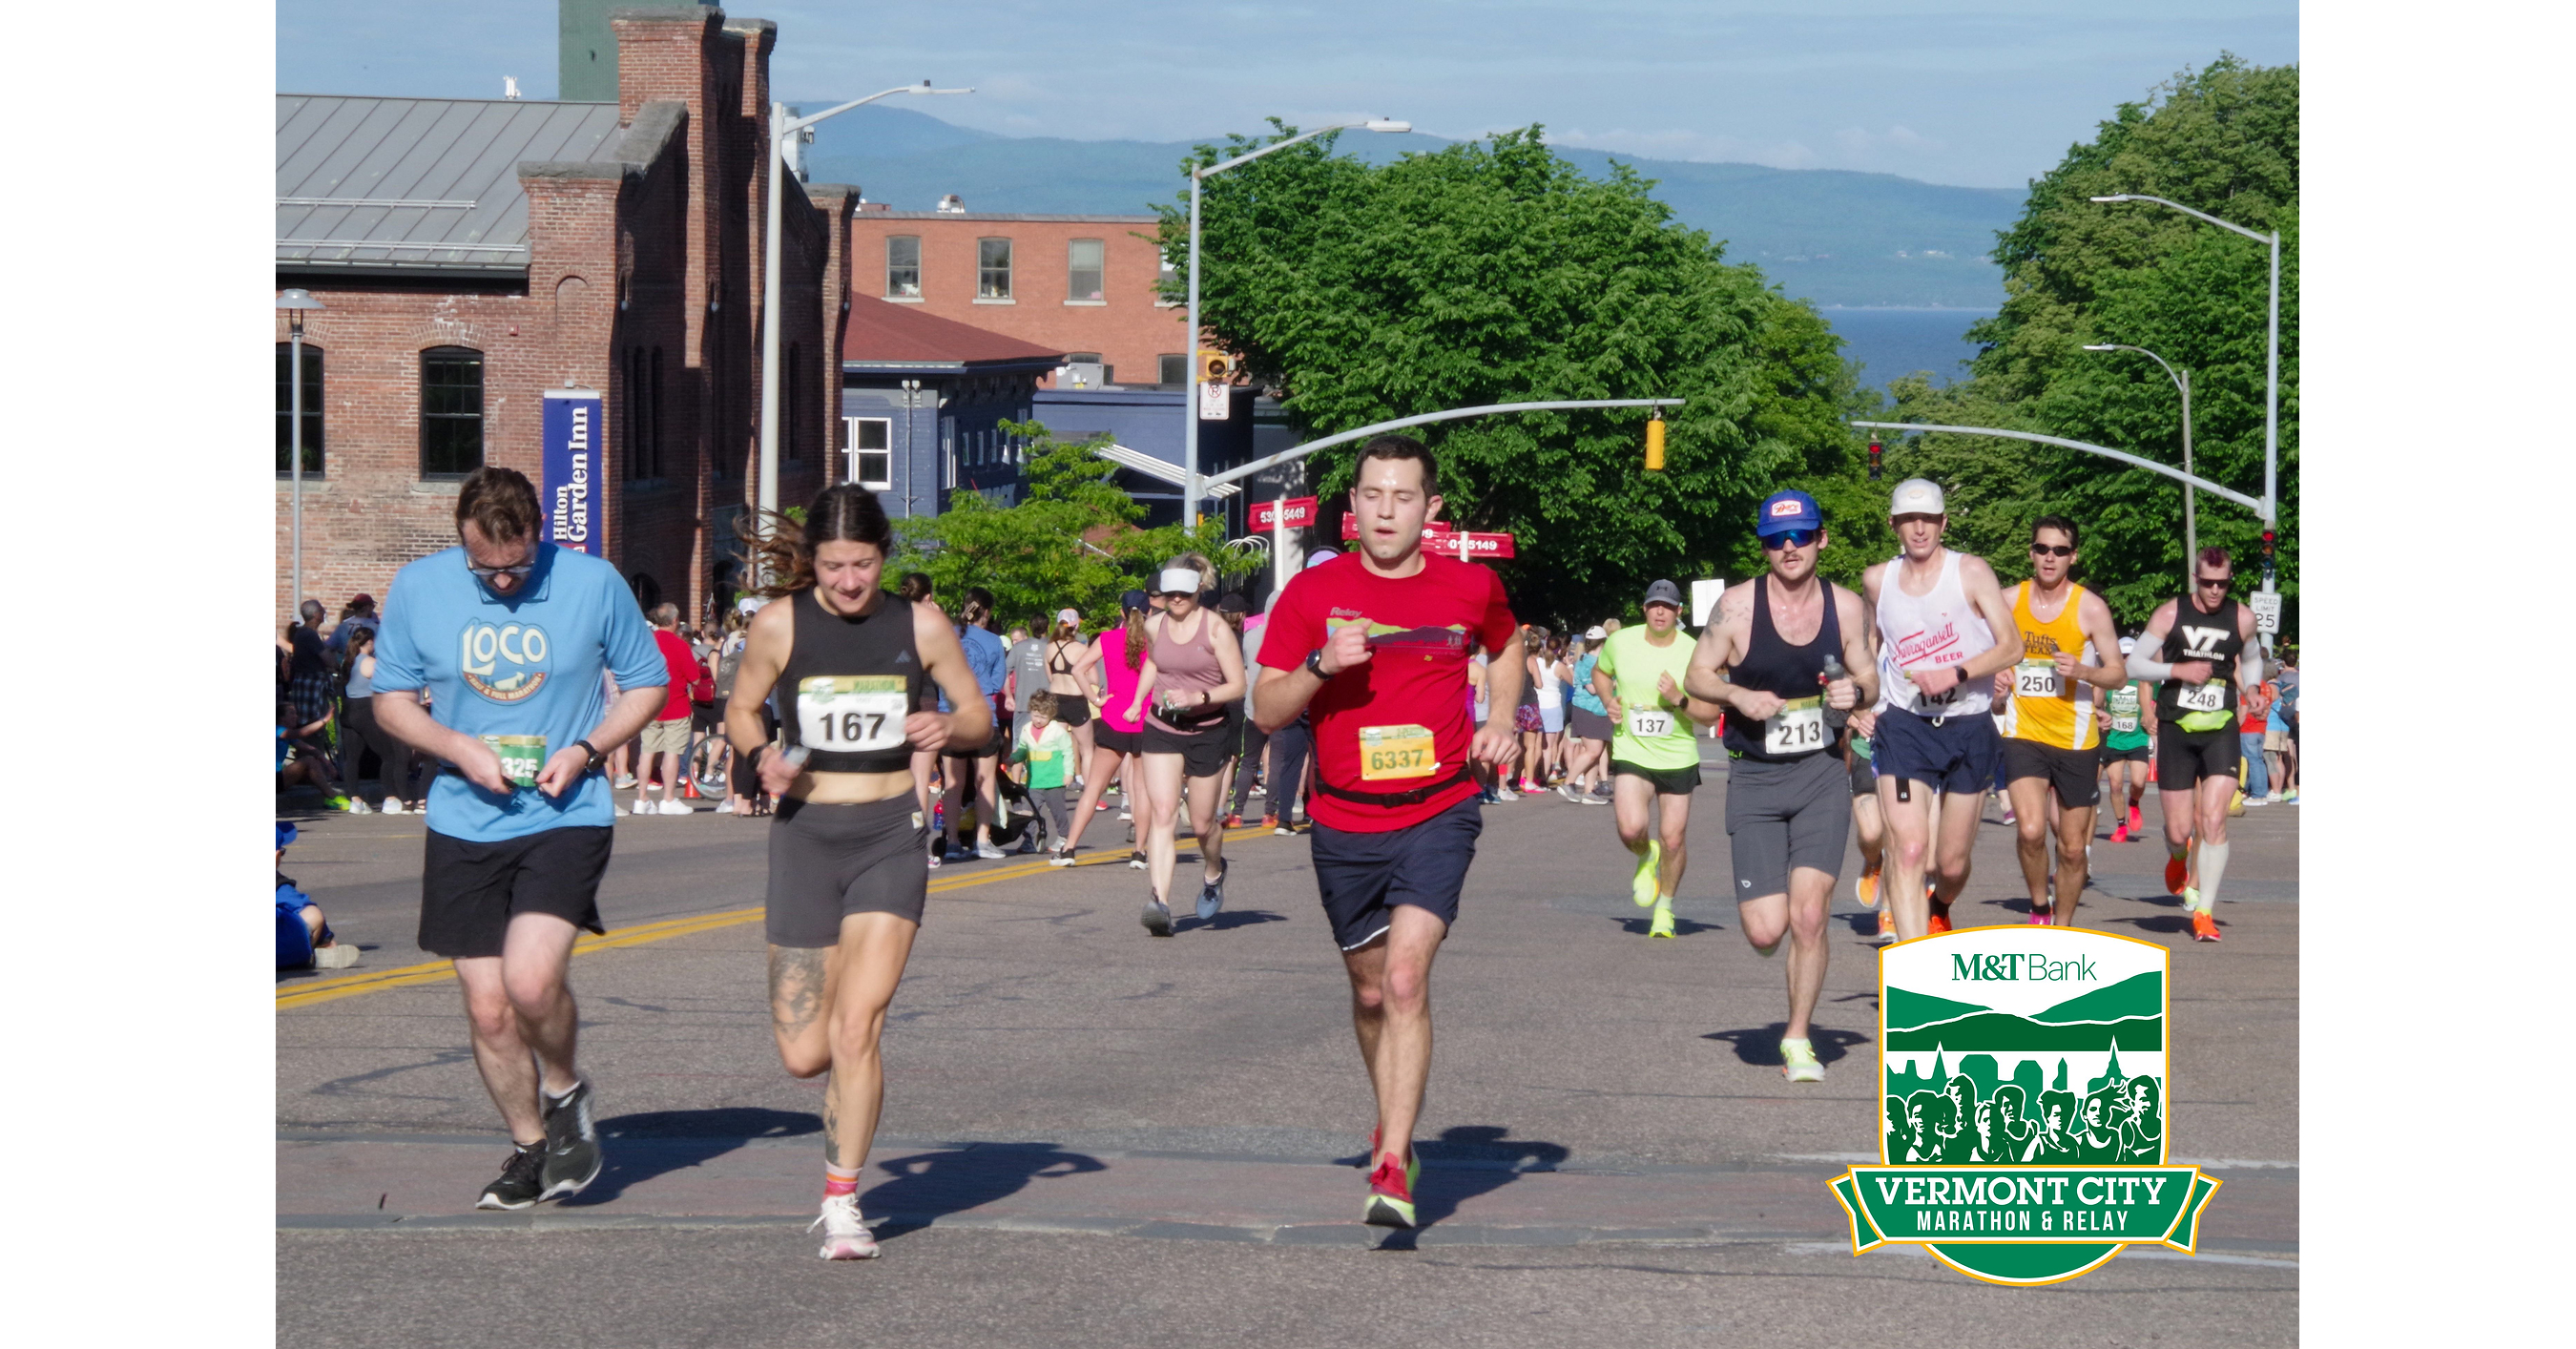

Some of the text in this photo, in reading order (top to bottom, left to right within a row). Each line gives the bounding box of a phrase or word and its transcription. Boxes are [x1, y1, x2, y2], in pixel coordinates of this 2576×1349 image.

[567, 406, 588, 543] Garden Inn
[553, 486, 569, 541] Hilton
[2254, 596, 2278, 605] SPEED
[1330, 607, 1362, 618] Relay
[2255, 612, 2275, 628] 25
[2025, 632, 2056, 646] Tufts
[2182, 625, 2231, 653] VT
[463, 625, 547, 676] LOCO
[1935, 652, 1963, 664] BEER
[2183, 649, 2225, 661] TRIATHLON
[508, 676, 542, 700] MARATHON
[2022, 675, 2056, 693] 250
[2187, 691, 2216, 707] 248
[819, 712, 886, 742] 167
[1637, 717, 1666, 733] 137
[1778, 720, 1820, 745] 213
[2117, 721, 2133, 730] 168
[1371, 749, 1423, 771] 6337
